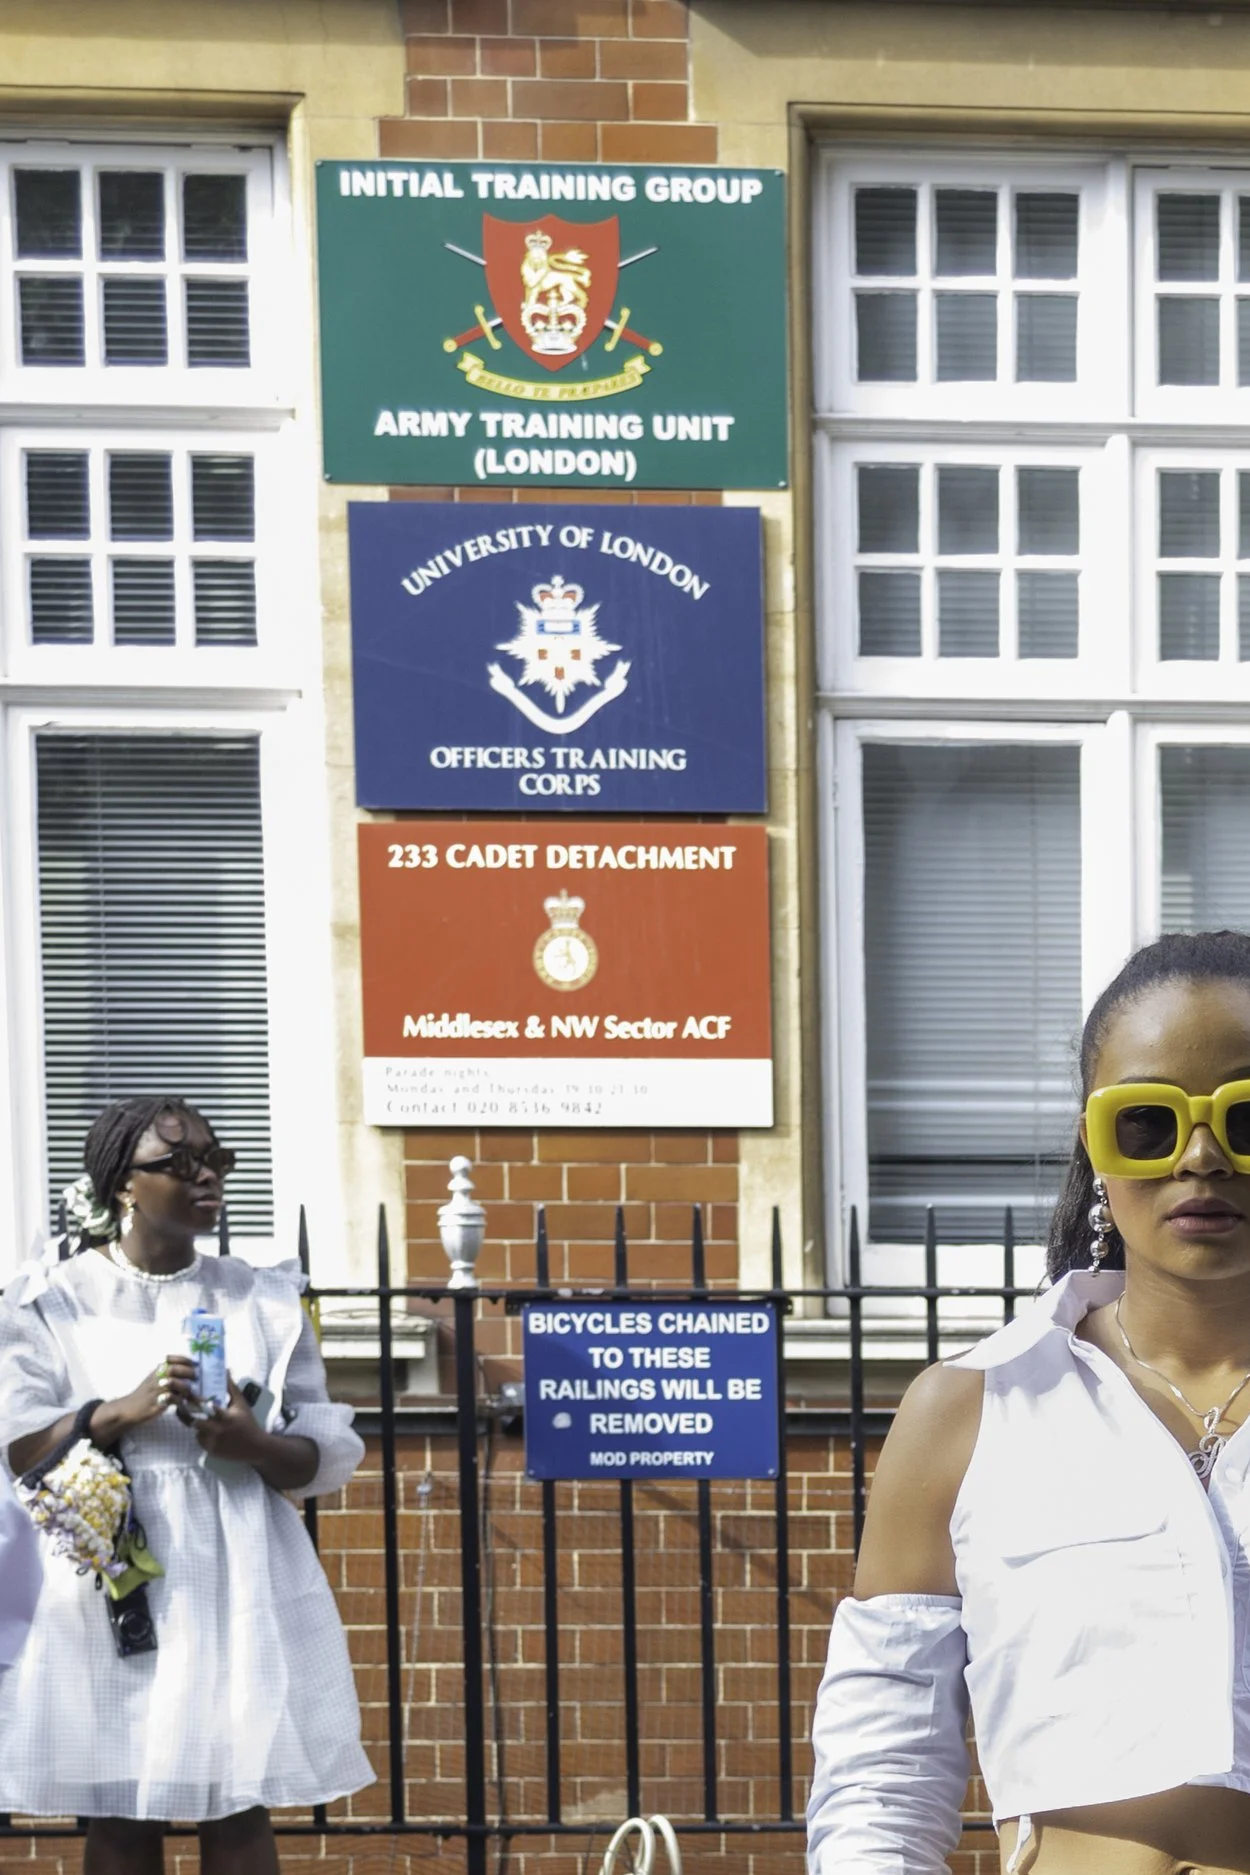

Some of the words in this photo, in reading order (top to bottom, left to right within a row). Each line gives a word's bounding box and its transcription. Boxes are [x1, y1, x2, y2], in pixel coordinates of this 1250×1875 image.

[339, 170, 464, 200] INITIAL
[471, 172, 637, 202] TRAINING
[645, 175, 763, 204] GROUP
[374, 411, 471, 438] ARMY
[480, 412, 643, 440] TRAINING
[652, 415, 735, 441] UNIT
[474, 449, 637, 481] (LONDON)
[401, 524, 554, 596] UNIVERSITY
[559, 525, 594, 548] OF
[600, 531, 711, 600] LONDON
[430, 747, 545, 769] OFFICERS
[551, 747, 687, 771] TRAINING
[519, 773, 601, 796] CORPS
[388, 844, 438, 869] 233
[445, 844, 538, 869] CADET
[546, 845, 737, 870] DETACHMENT
[402, 1013, 519, 1039] Middlesex
[524, 1015, 546, 1039] &
[551, 1015, 600, 1039] NW
[604, 1015, 678, 1040] Sector
[681, 1015, 732, 1040] ACF
[386, 1100, 457, 1113] Contact
[528, 1312, 653, 1335] BICYCLES
[657, 1312, 770, 1335] CHAINED
[588, 1346, 624, 1369] TO
[628, 1346, 711, 1369] THESE
[539, 1378, 656, 1401] RAILINGS
[661, 1378, 722, 1401] WILL
[727, 1378, 763, 1401] BE
[589, 1412, 714, 1435] REMOVED
[589, 1451, 627, 1467] MOD
[630, 1451, 715, 1467] PROPERTY
